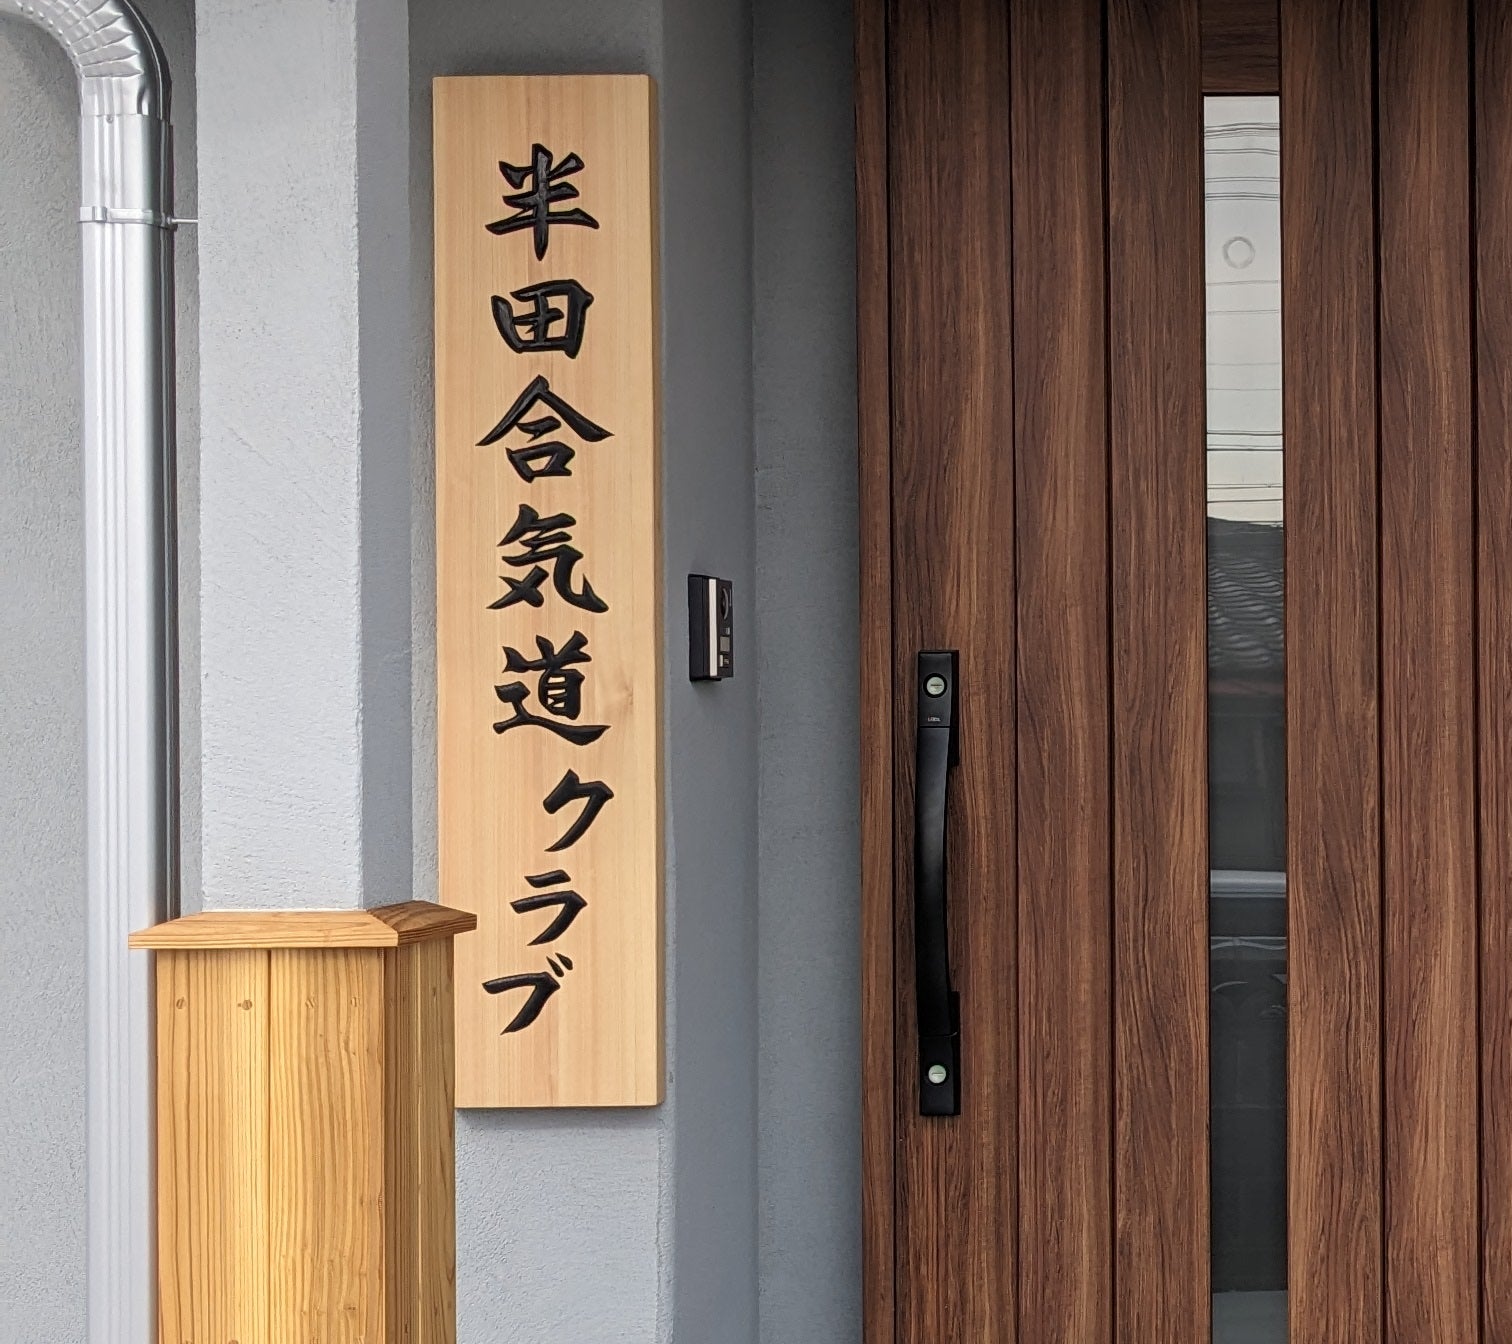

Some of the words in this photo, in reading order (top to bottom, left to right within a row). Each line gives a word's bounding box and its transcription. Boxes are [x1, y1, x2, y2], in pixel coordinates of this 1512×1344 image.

[475, 142, 615, 1035] 半田合気道クラブ
